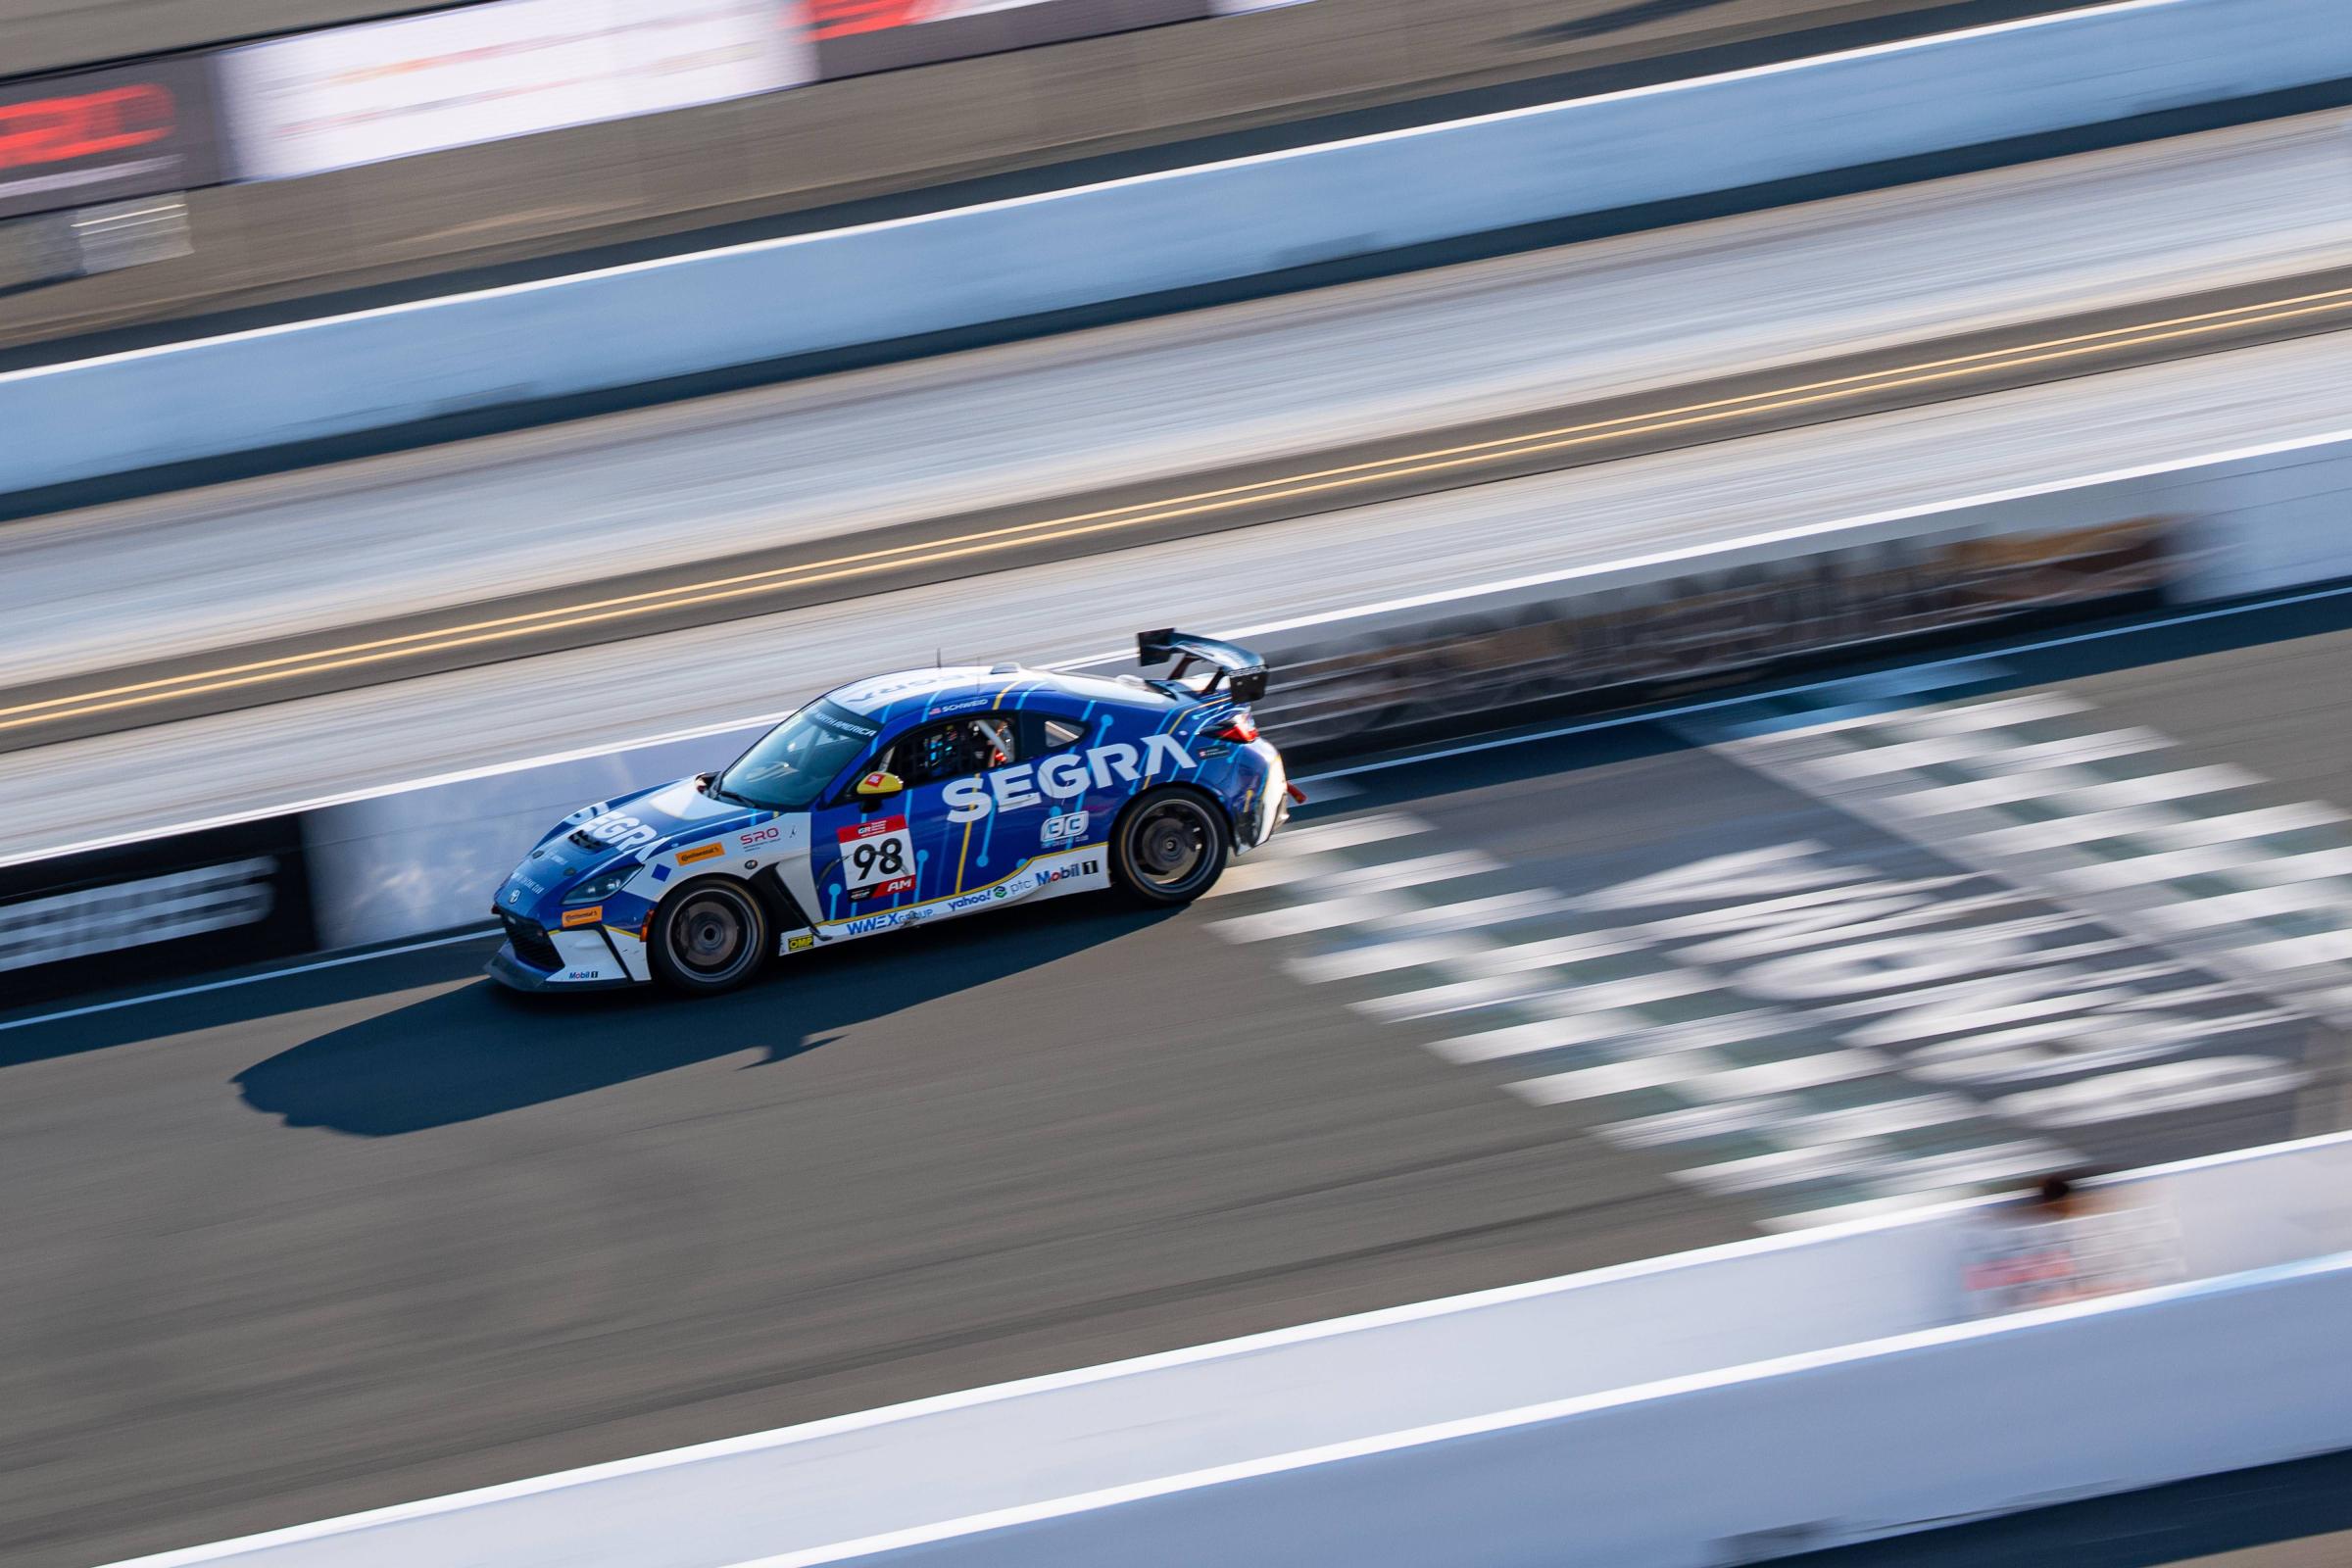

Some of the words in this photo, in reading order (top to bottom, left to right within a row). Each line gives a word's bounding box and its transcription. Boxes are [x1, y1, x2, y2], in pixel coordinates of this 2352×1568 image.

[941, 699, 989, 712] SCHWEID
[831, 720, 877, 737] AMERICA
[942, 734, 1198, 823] SEGRA
[740, 827, 779, 845] SRO
[854, 838, 903, 881] 98
[1036, 862, 1080, 886] Mobil
[1084, 861, 1097, 874] 1
[887, 878, 912, 893] AM
[948, 890, 991, 911] yahoo!
[789, 937, 812, 949] OMP
